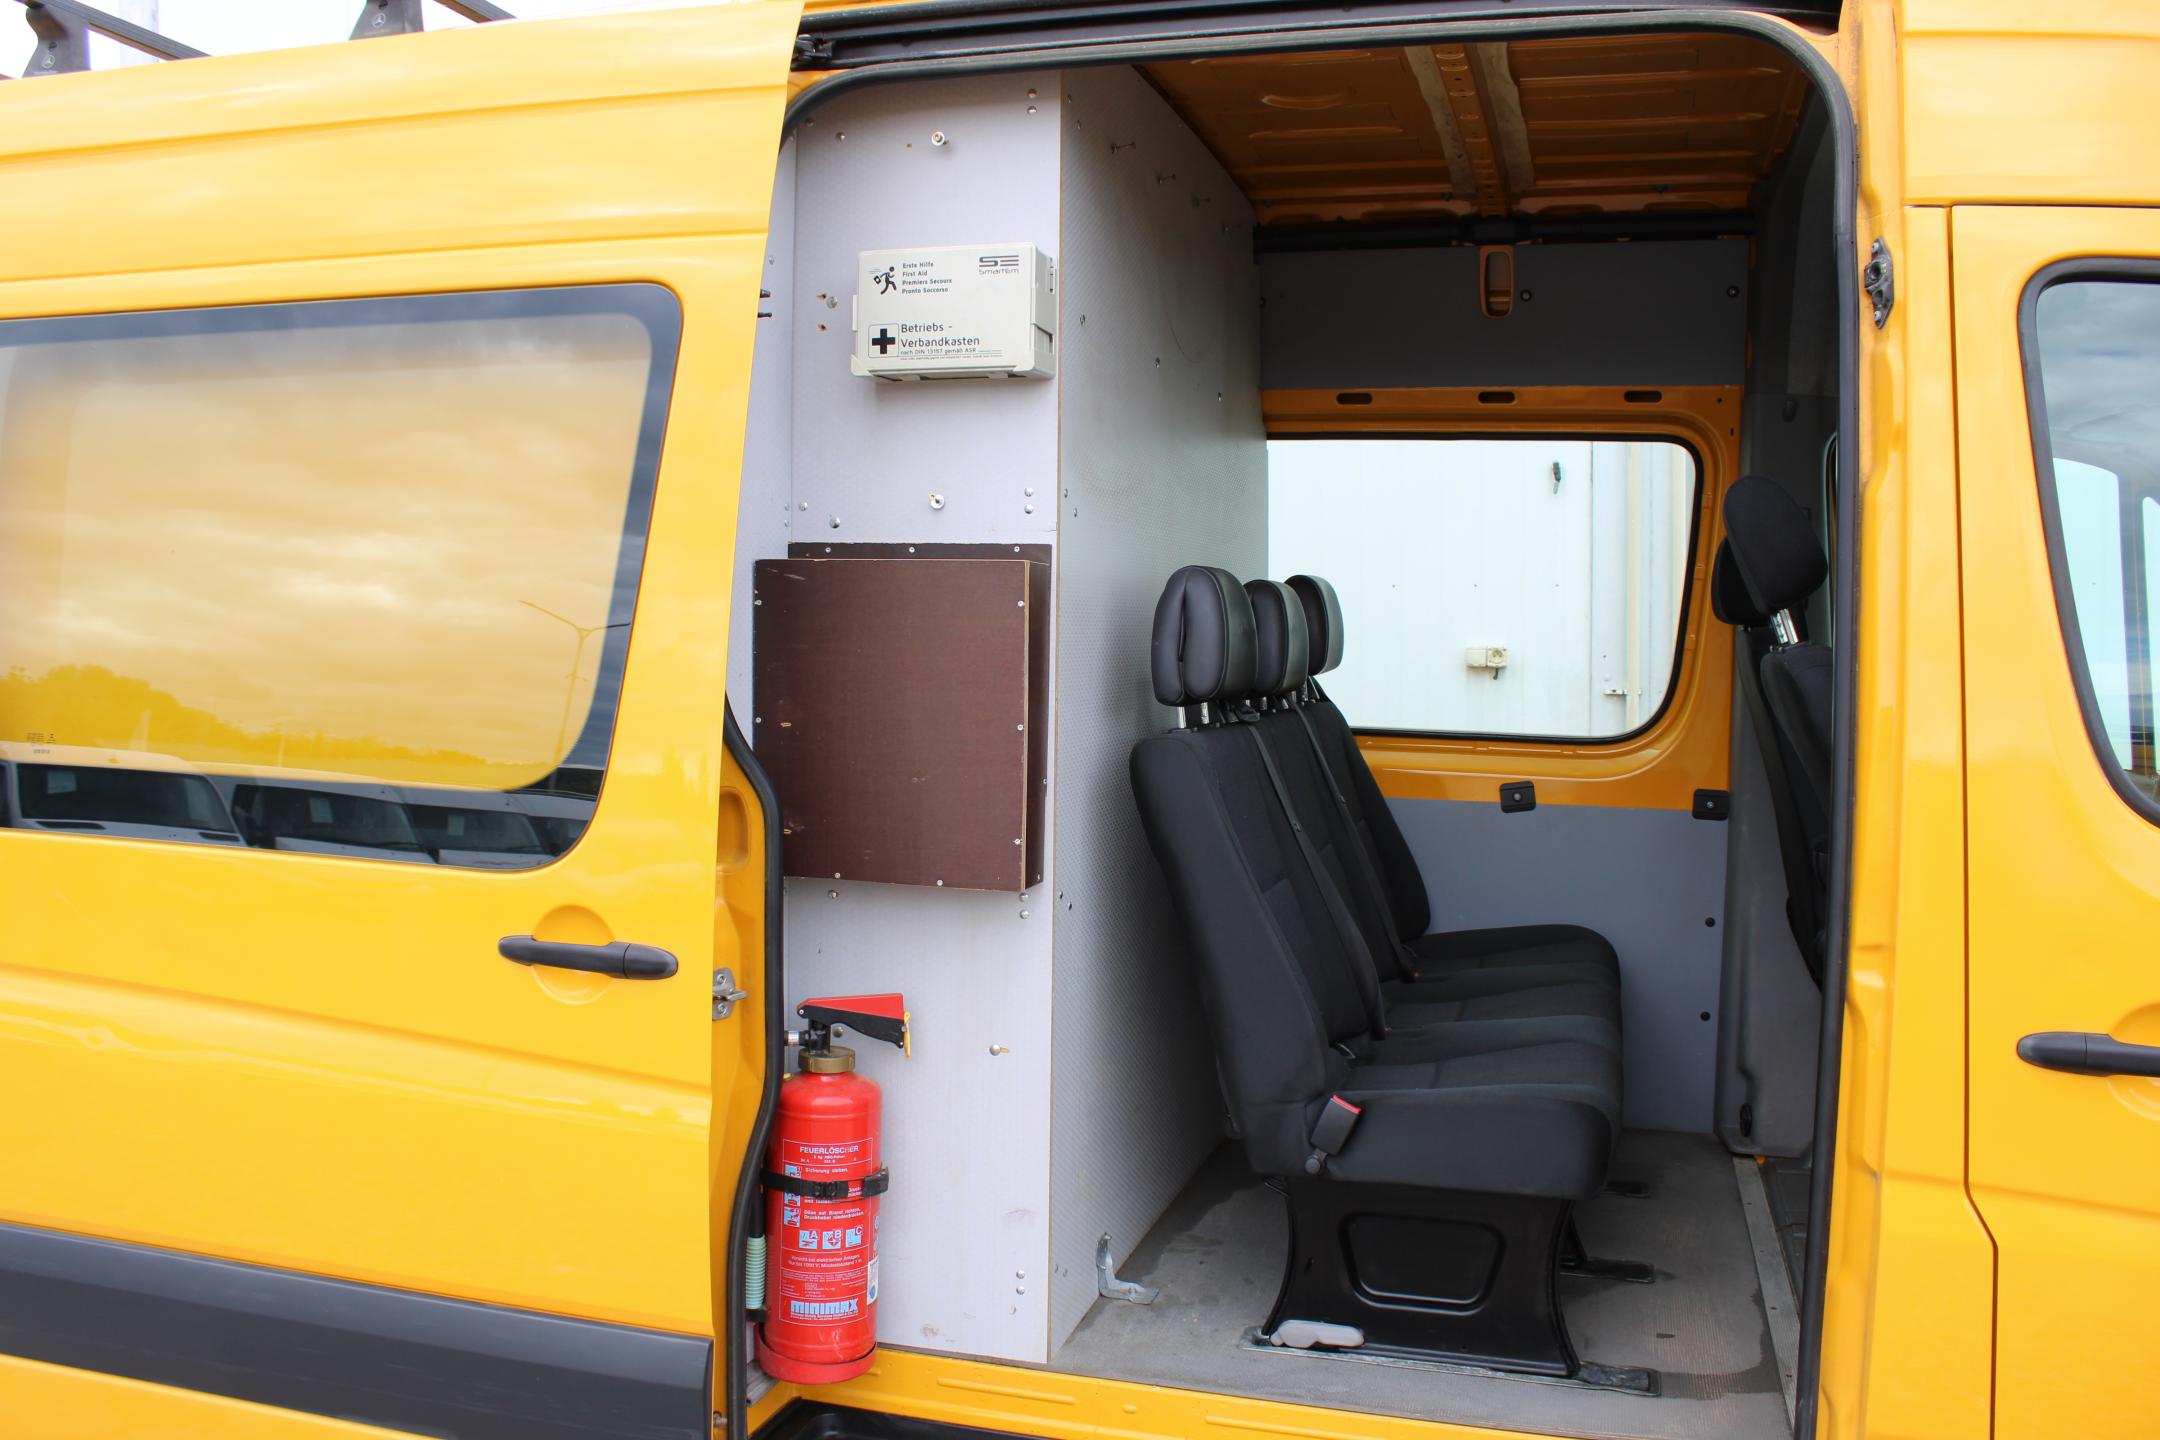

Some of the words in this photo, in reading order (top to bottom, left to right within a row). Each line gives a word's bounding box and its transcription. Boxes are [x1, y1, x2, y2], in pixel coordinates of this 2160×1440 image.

[901, 322, 944, 333] Betriebs
[901, 336, 980, 348] Verbandkasten
[809, 1230, 818, 1239] A
[834, 1229, 842, 1239] B
